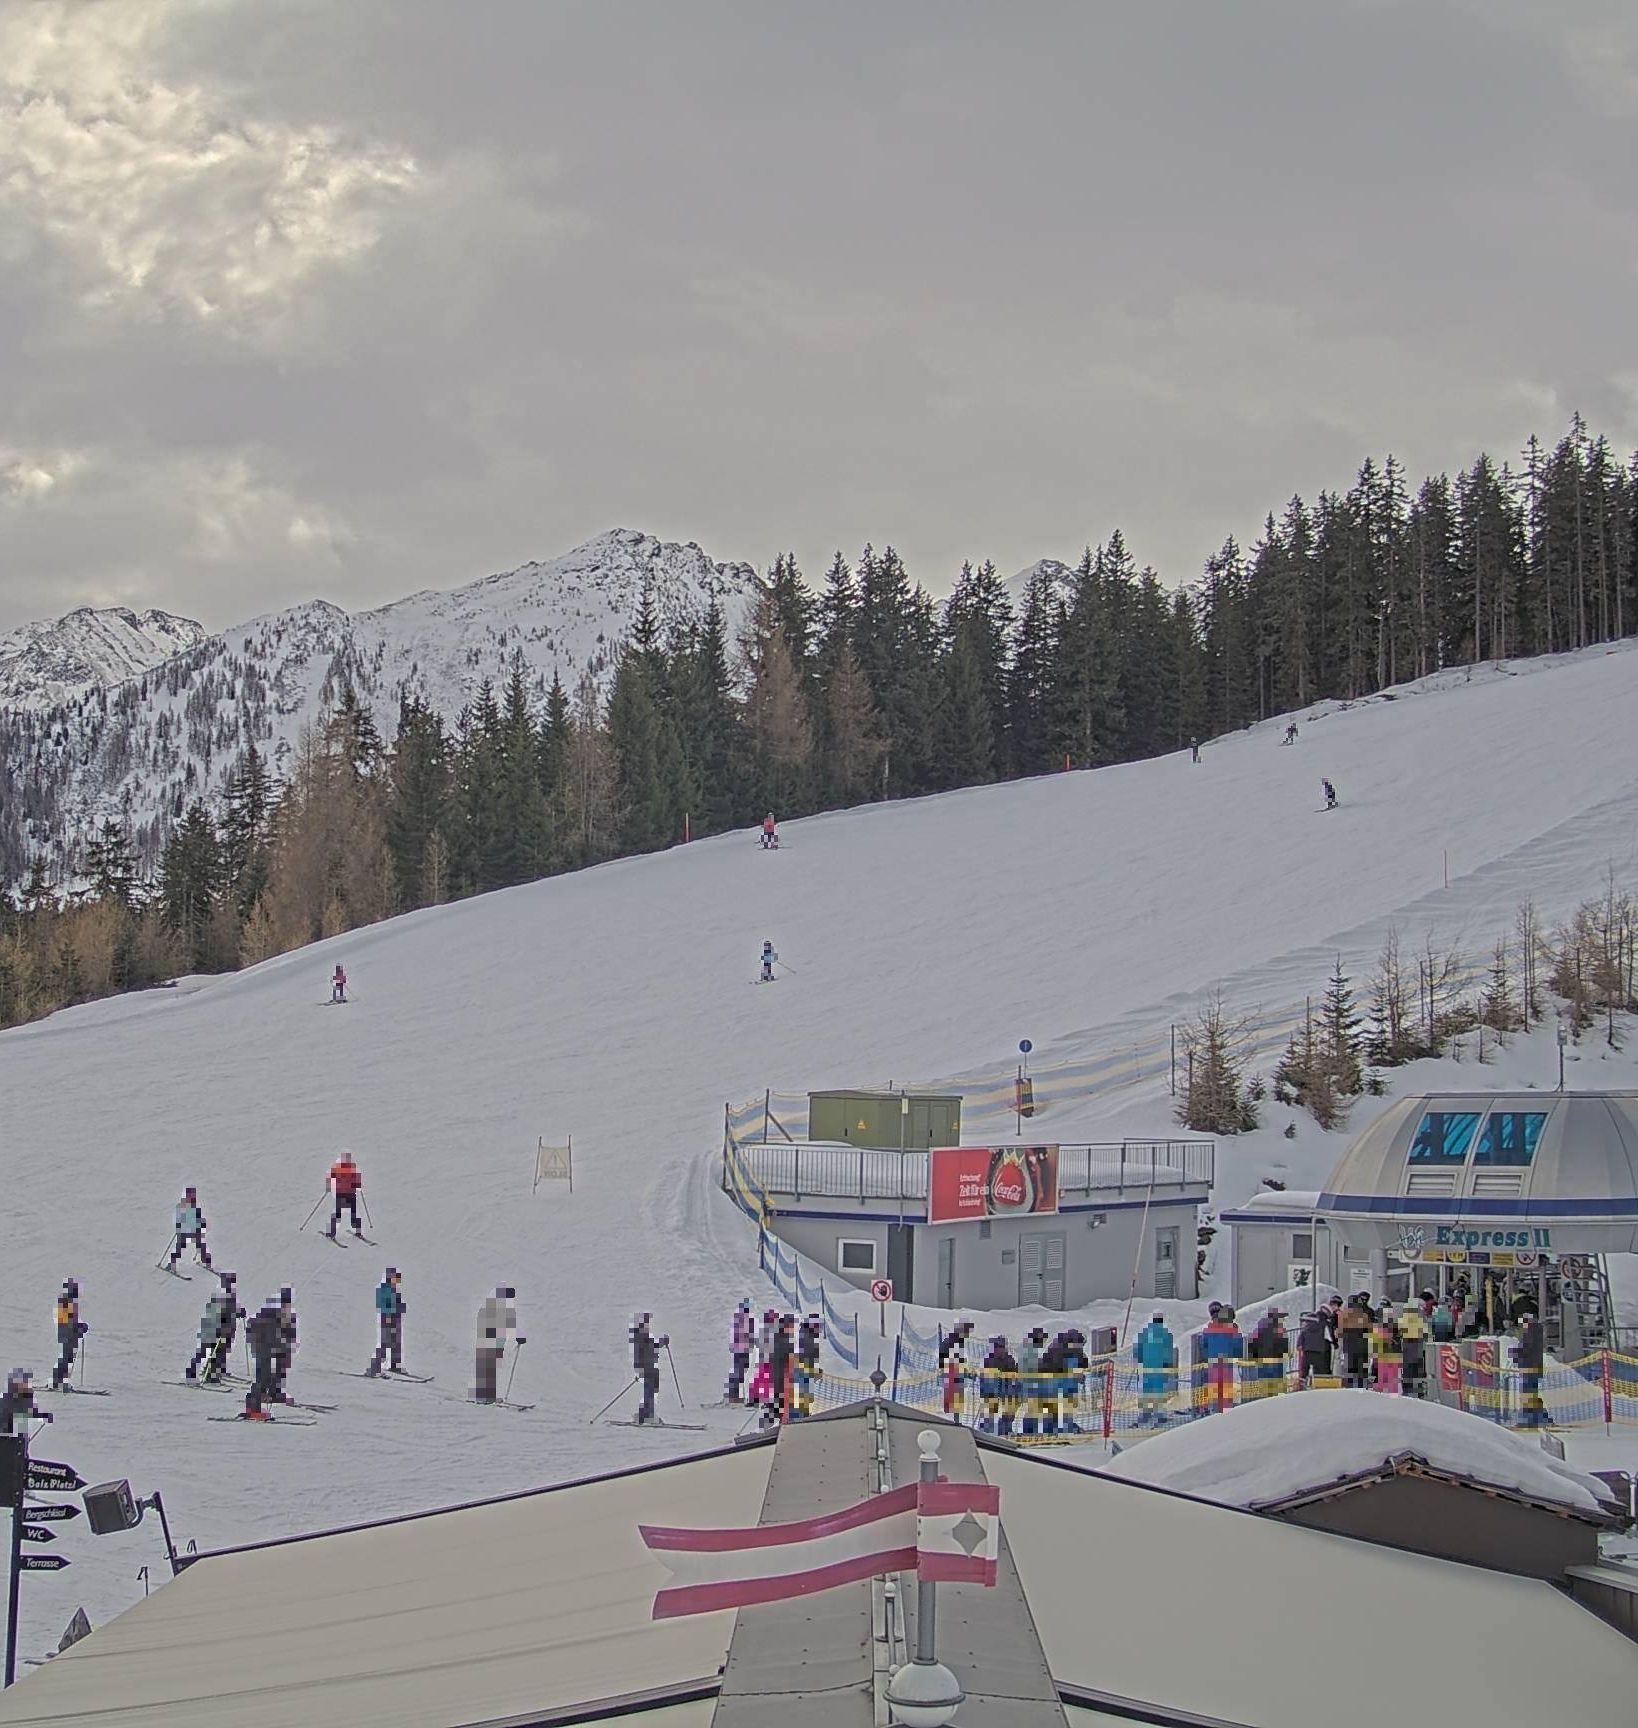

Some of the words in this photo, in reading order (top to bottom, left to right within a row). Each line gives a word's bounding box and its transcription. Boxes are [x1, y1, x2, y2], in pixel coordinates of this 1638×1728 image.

[1436, 1226, 1529, 1248] Express
[28, 1461, 67, 1477] Restaurant
[27, 1528, 45, 1539] WC
[26, 1557, 60, 1569] Terrasse
